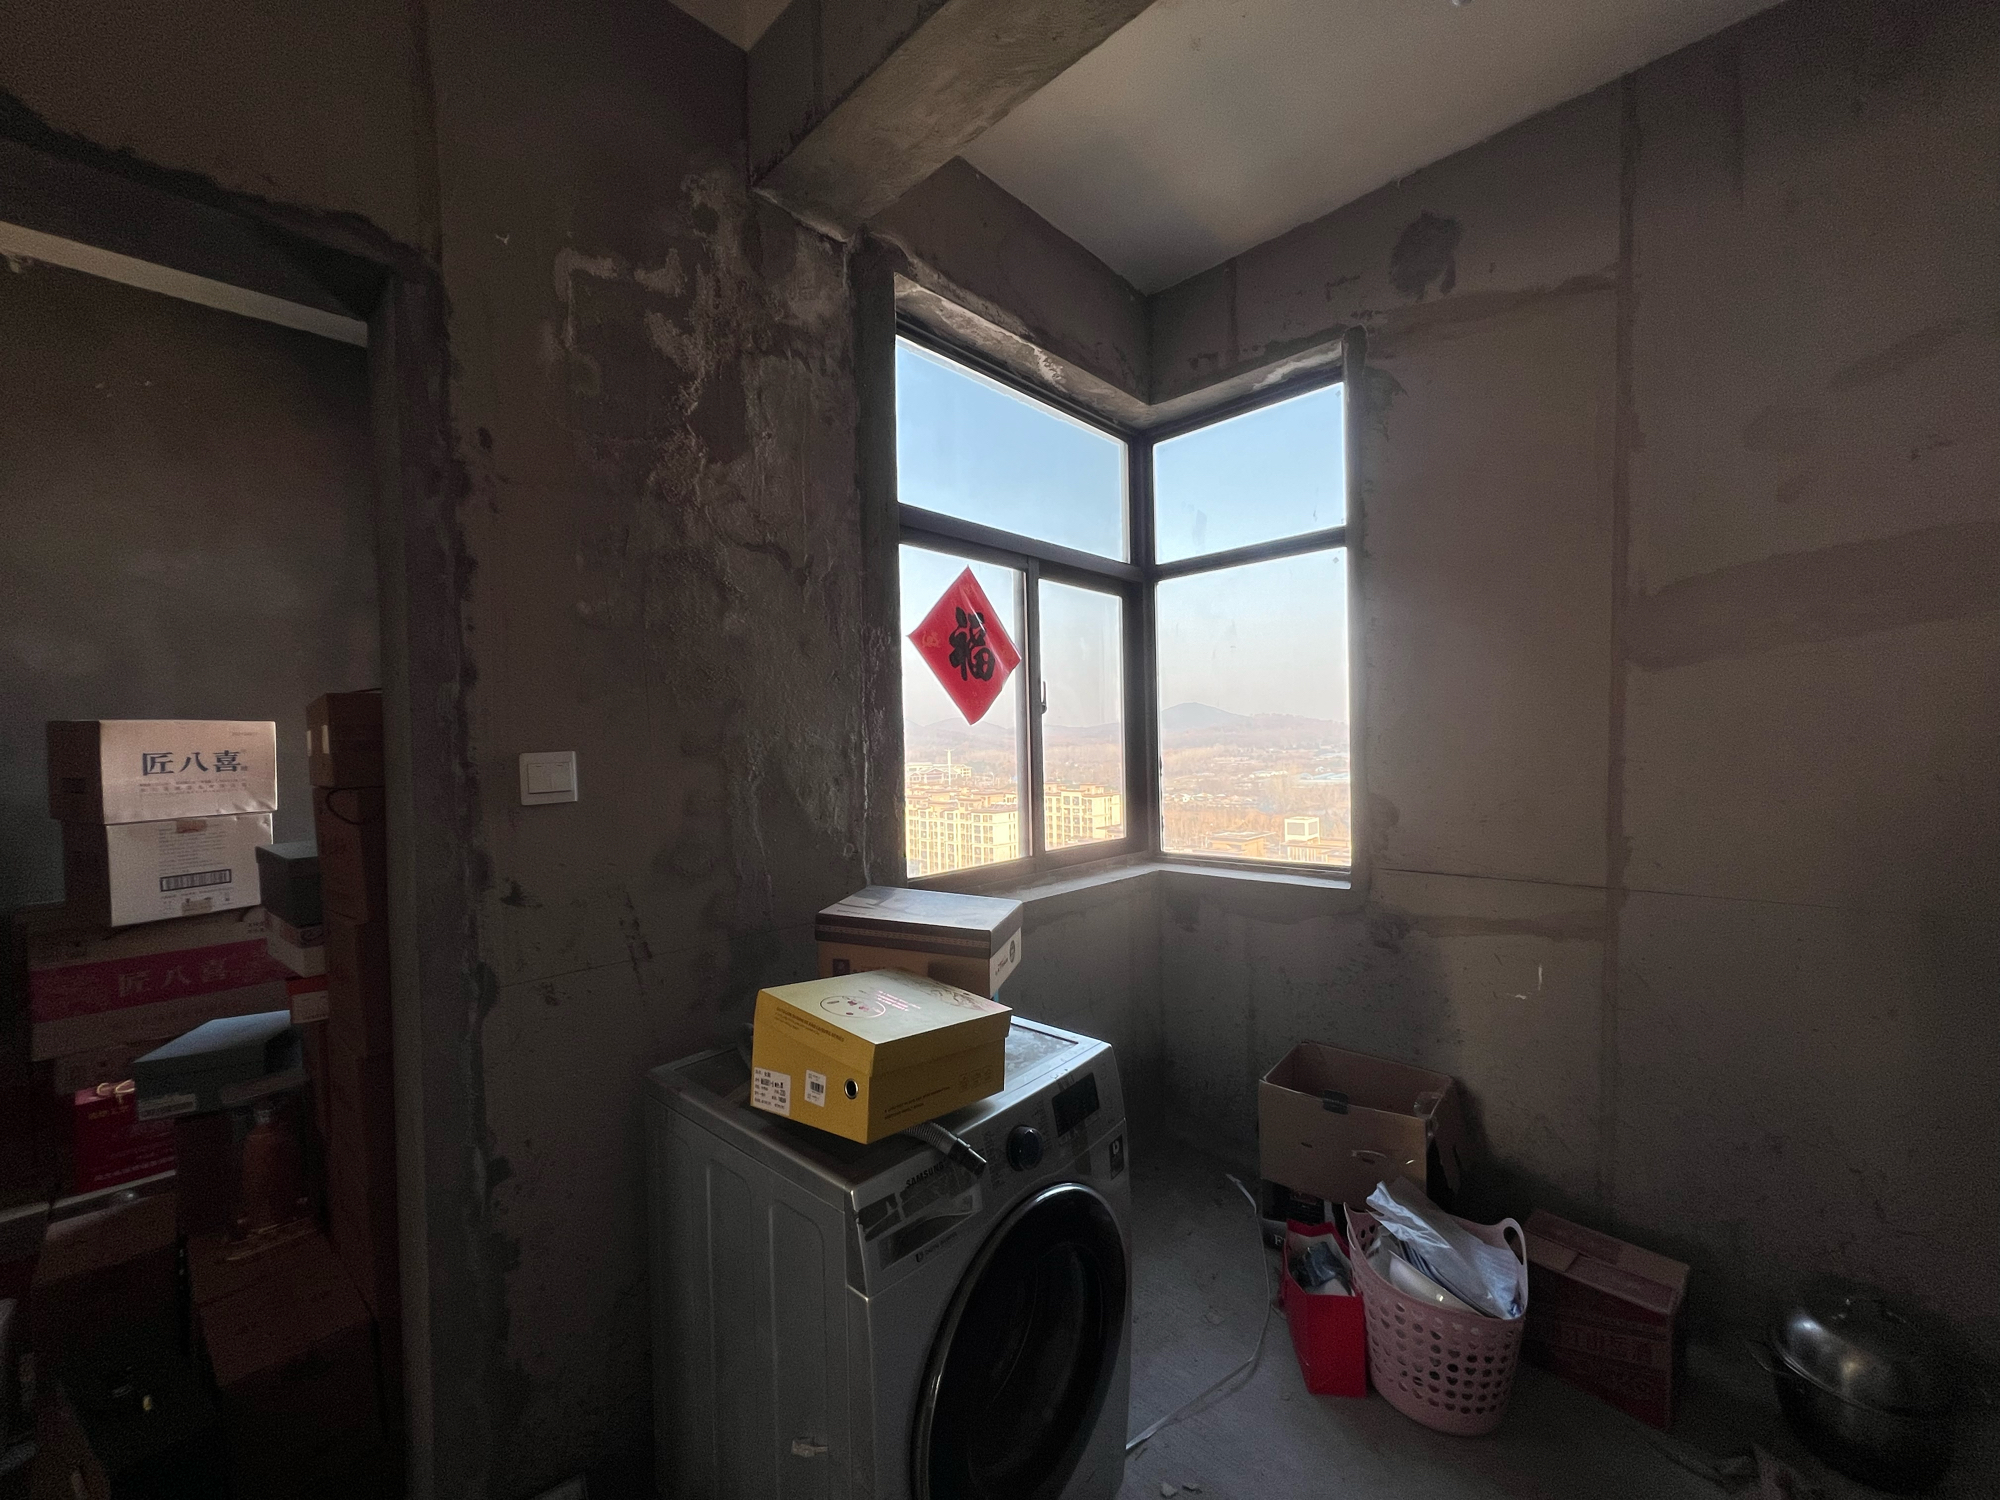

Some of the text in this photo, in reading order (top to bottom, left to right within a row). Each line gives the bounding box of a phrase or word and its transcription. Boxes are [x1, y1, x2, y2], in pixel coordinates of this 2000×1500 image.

[949, 607, 996, 681] 福
[142, 749, 241, 776] 匠八喜
[118, 957, 227, 998] 匠八喜
[906, 1161, 944, 1189] SAMSUNG
